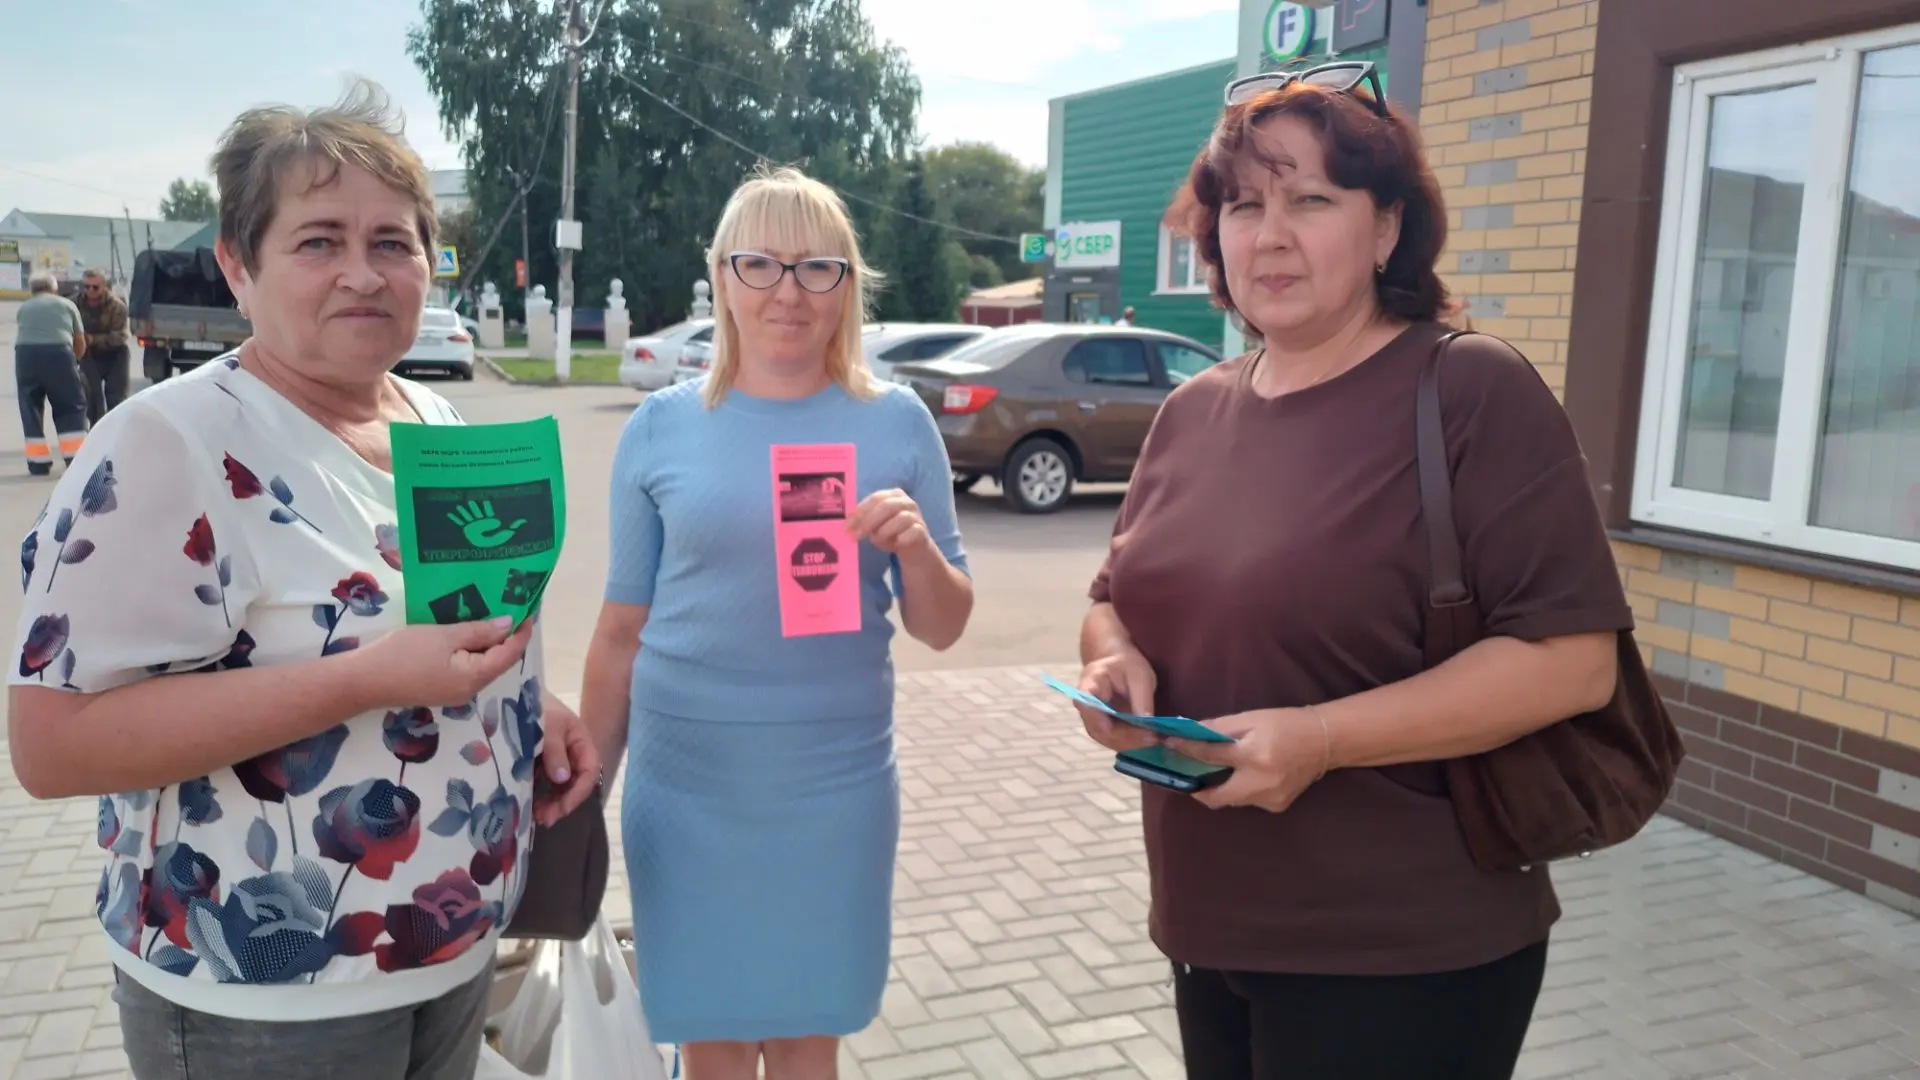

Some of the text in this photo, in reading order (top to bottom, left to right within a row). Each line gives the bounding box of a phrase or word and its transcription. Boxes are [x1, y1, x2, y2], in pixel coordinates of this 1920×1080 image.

[1277, 7, 1297, 49] F
[1075, 233, 1113, 255] СБЕР
[803, 551, 826, 564] STOP
